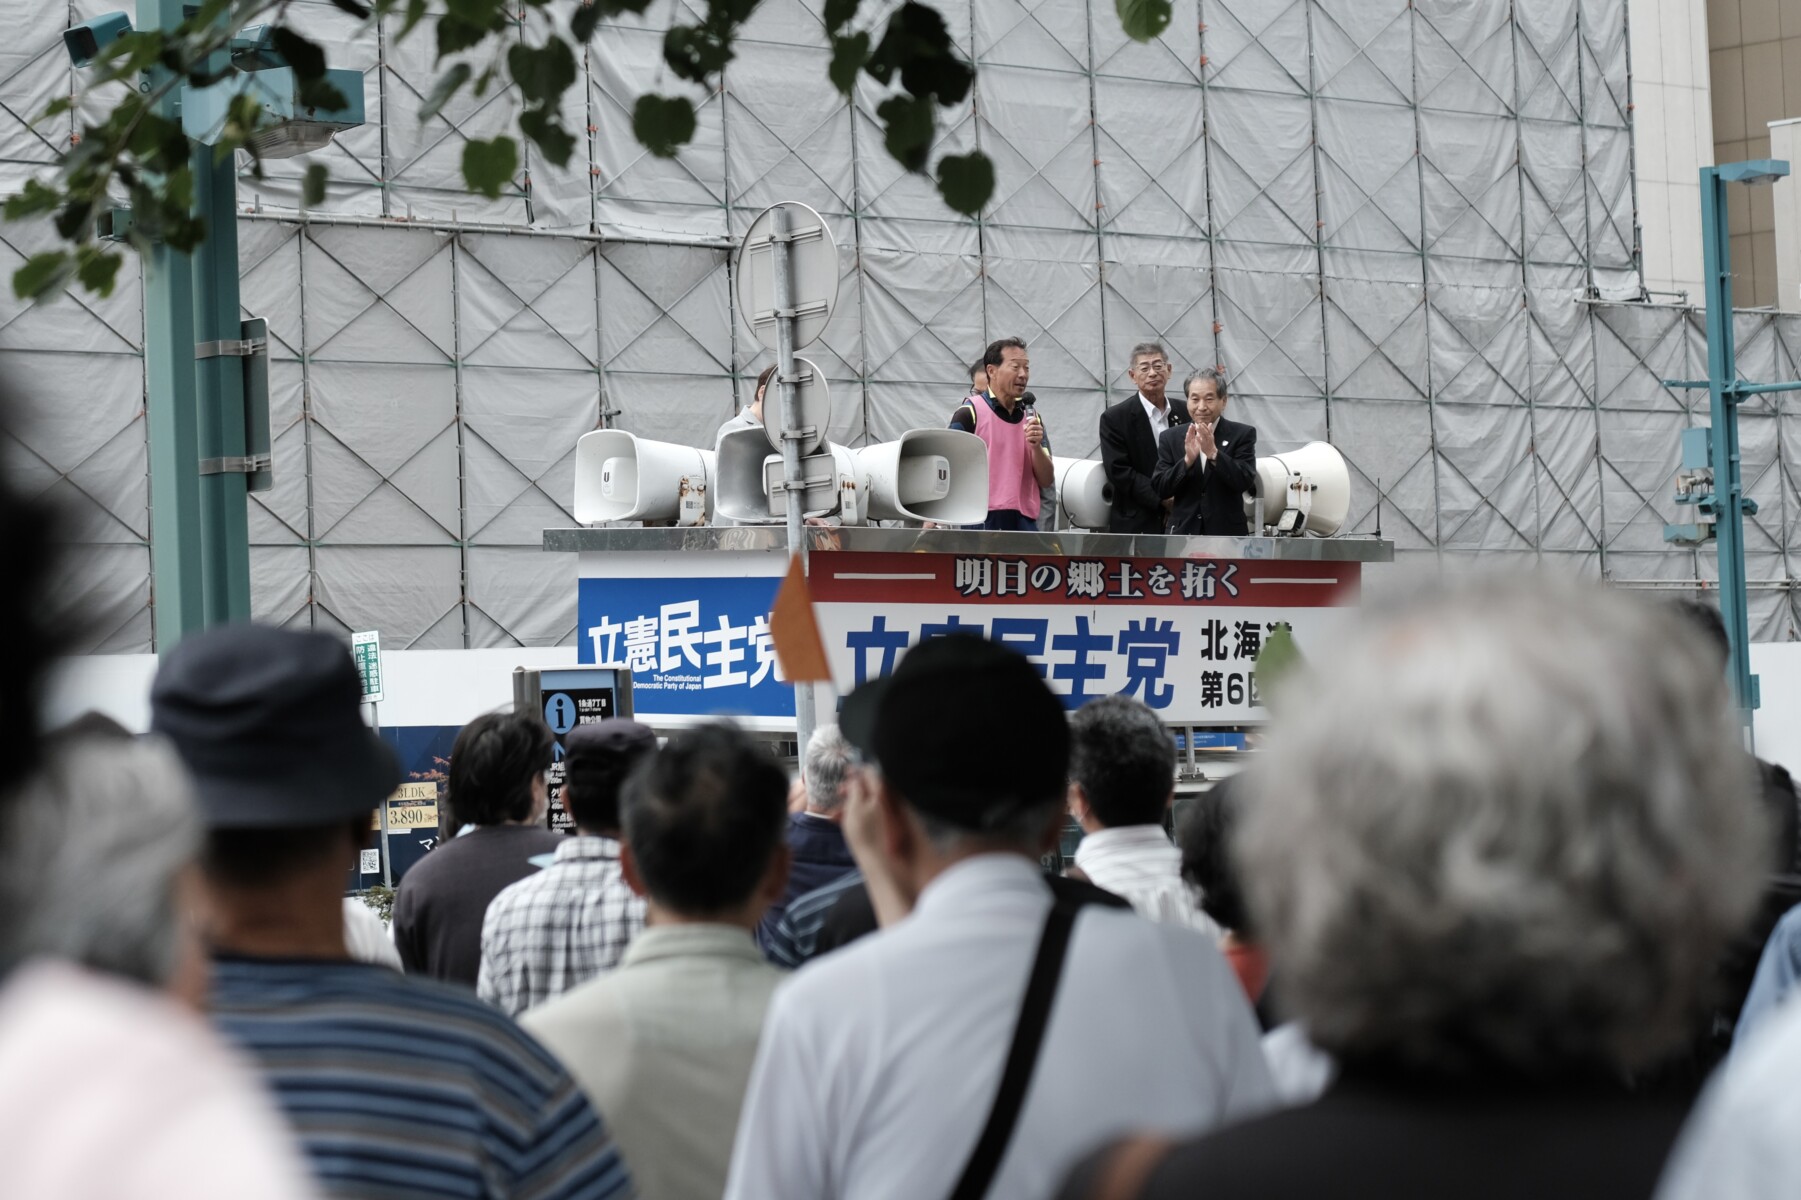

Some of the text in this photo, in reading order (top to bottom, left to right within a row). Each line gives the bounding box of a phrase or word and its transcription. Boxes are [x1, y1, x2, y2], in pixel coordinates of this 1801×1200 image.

[954, 557, 1240, 598] 明日の郷土を拓く
[588, 600, 787, 689] 立憲民主党
[1201, 619, 1292, 662] 北海
[653, 674, 702, 682] The Constitutional
[836, 615, 1181, 712] 立民主党
[633, 681, 663, 689] Democratic
[663, 682, 678, 691] Party
[685, 682, 702, 691] Japan
[398, 787, 425, 799] 3LDK
